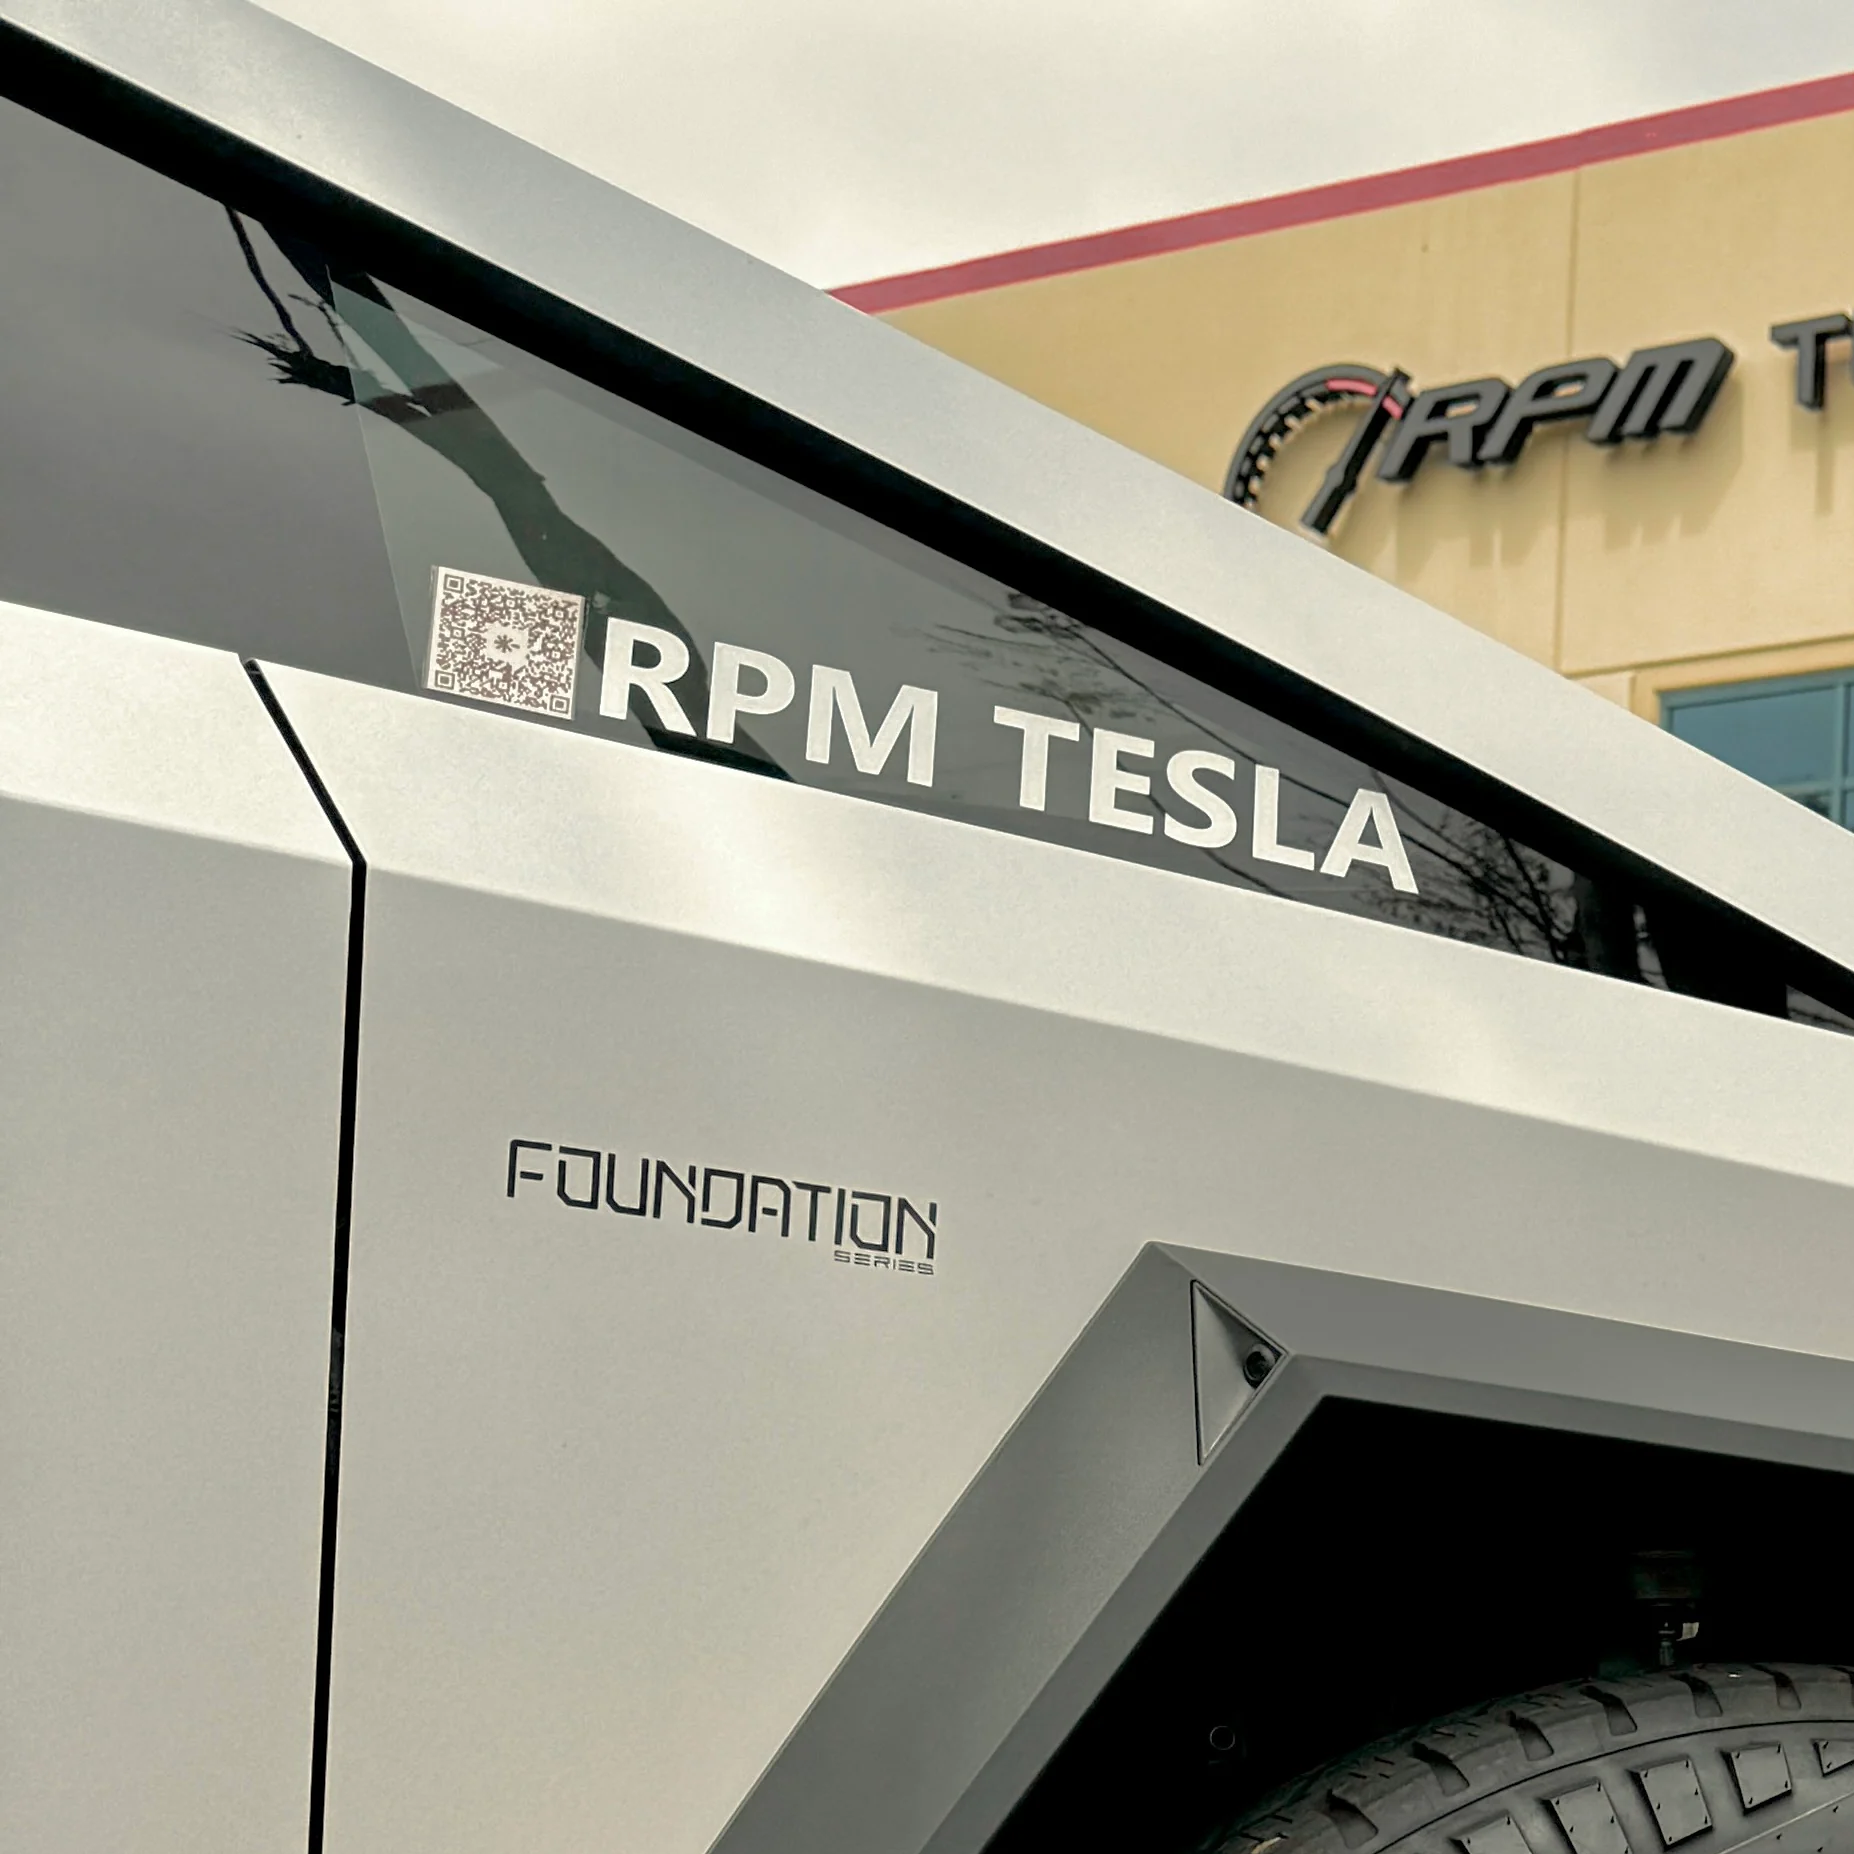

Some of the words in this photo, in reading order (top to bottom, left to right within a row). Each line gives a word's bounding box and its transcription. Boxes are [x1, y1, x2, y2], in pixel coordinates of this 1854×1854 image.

[1376, 336, 1735, 482] RPM
[599, 615, 940, 788] RPM
[993, 704, 1420, 894] TESLA
[506, 1138, 938, 1260] FOUNDATION
[833, 1249, 936, 1276] SERIES
